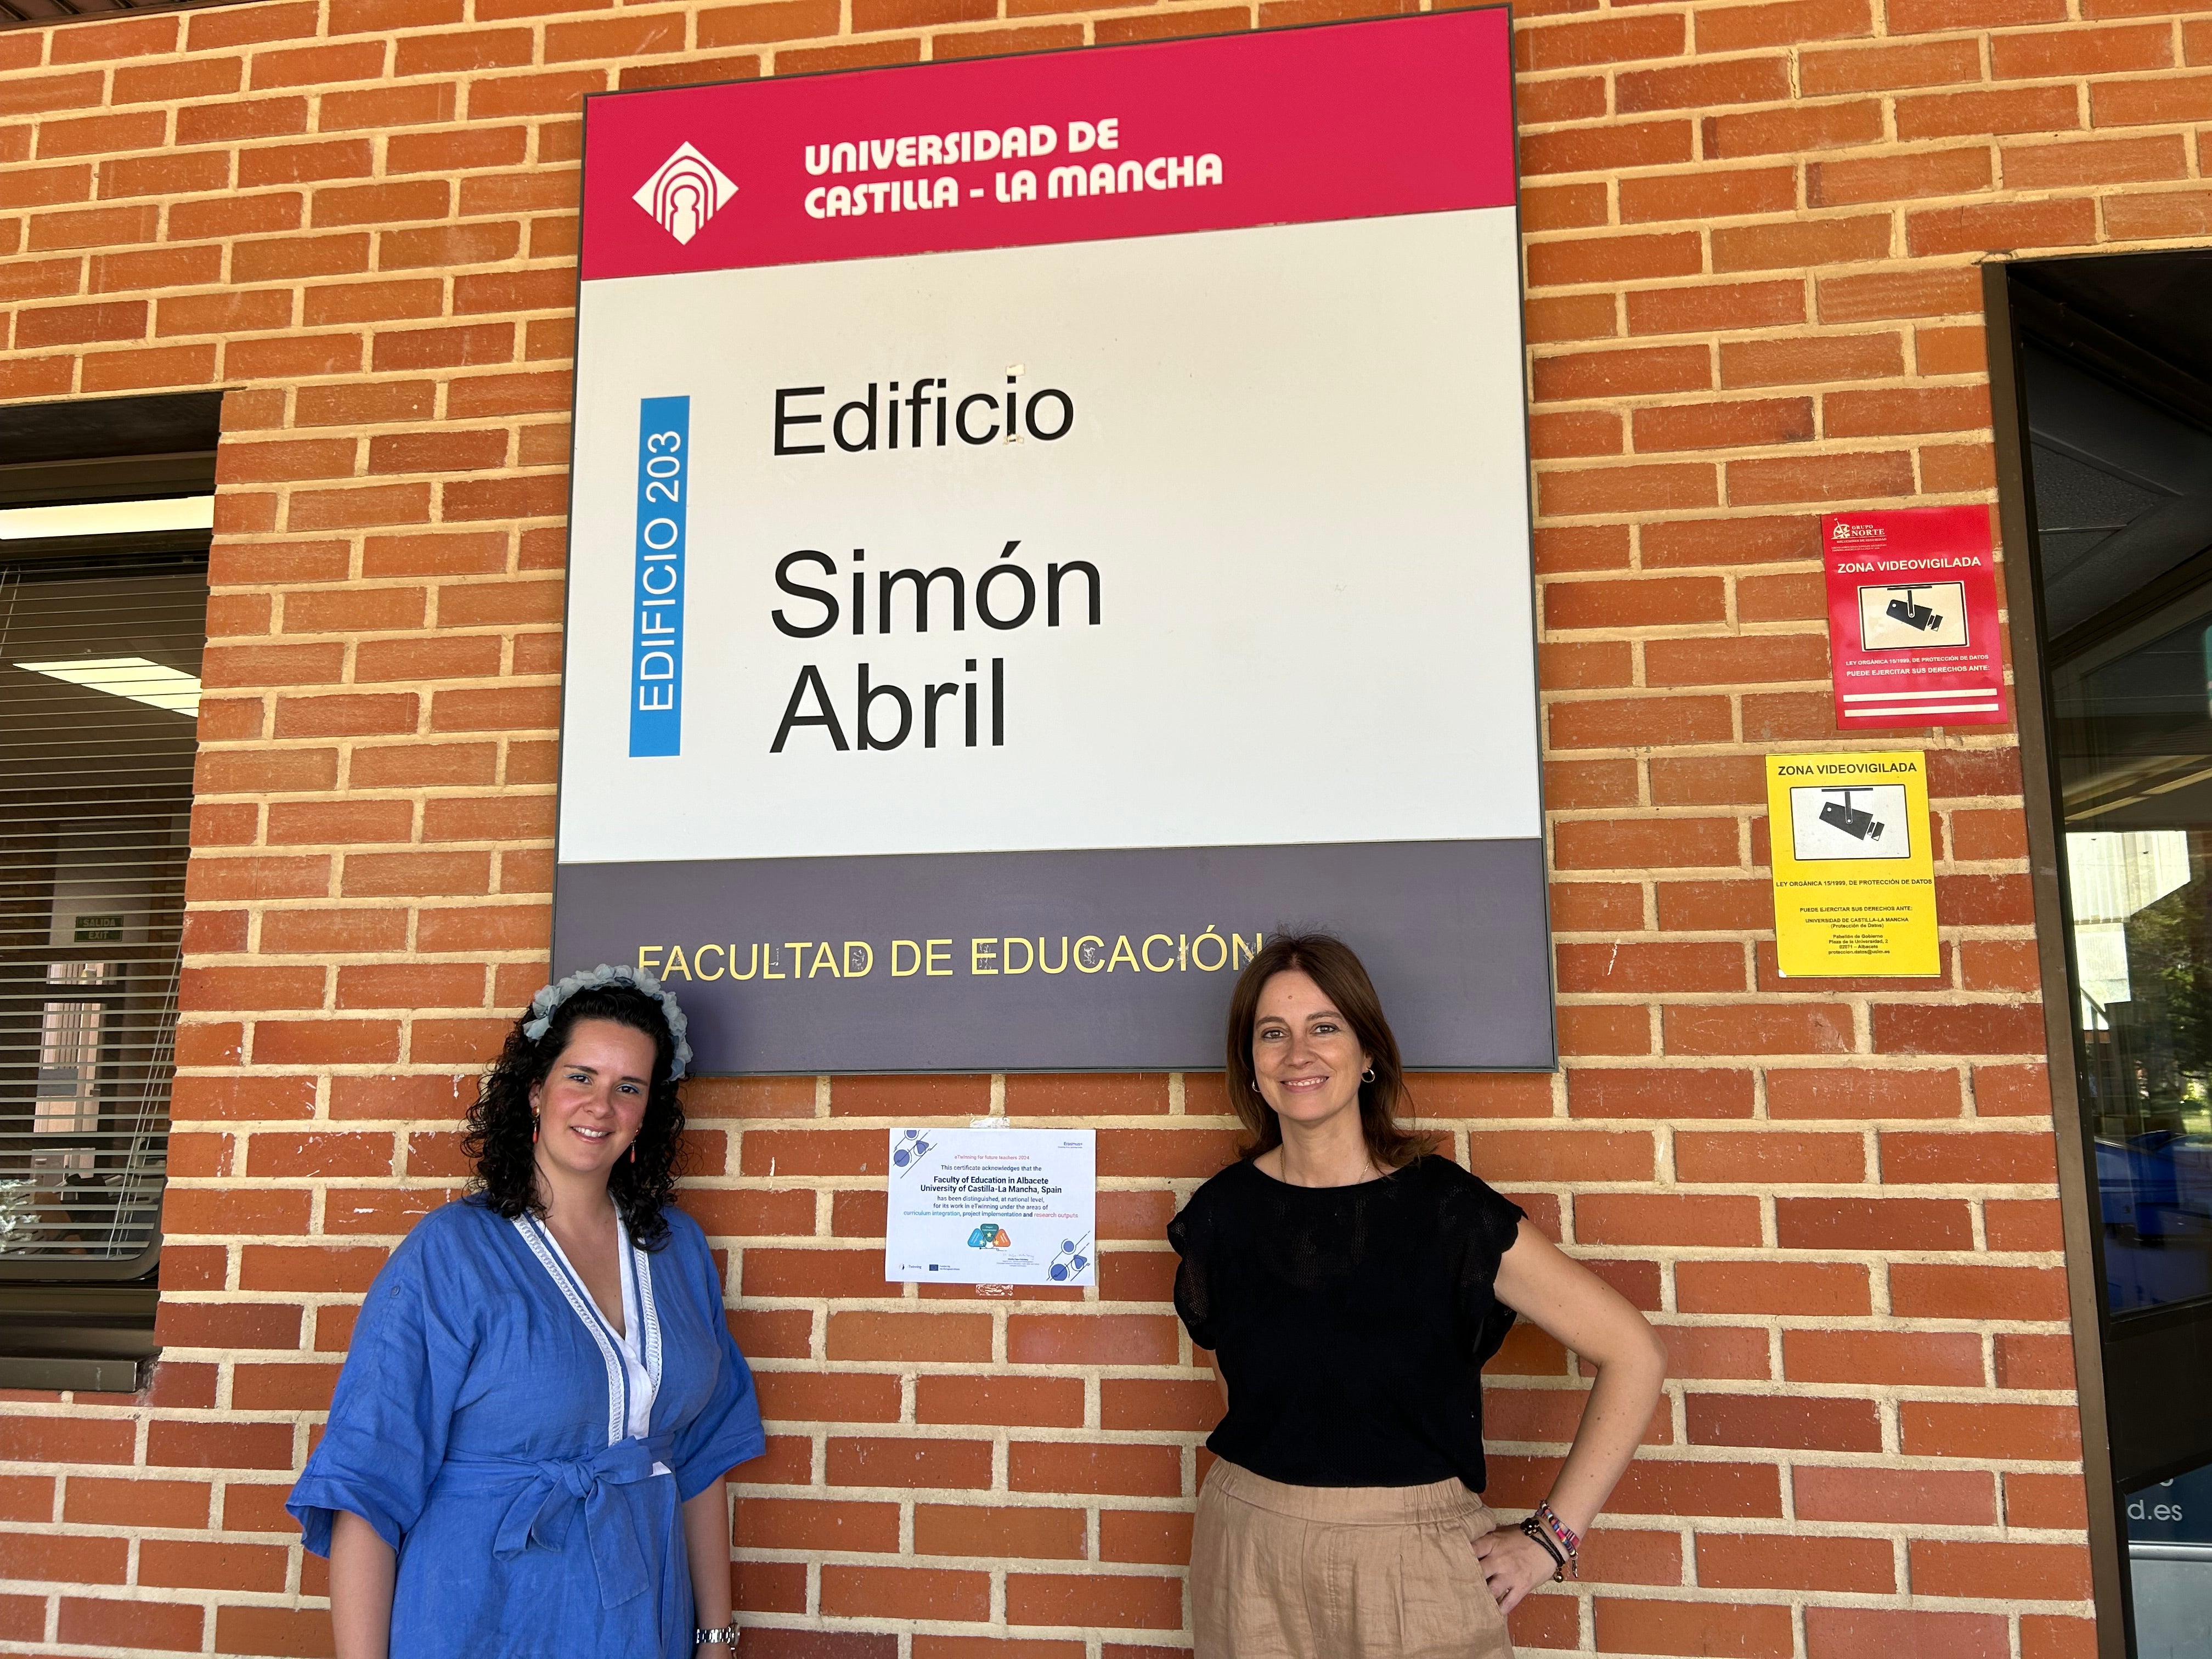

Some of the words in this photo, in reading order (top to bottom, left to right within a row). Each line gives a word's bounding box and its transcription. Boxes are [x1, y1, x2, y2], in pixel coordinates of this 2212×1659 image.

[805, 125, 1057, 176] UNIVERSIDAD
[1069, 117, 1119, 153] DE
[805, 176, 959, 218] CASTILLA
[969, 187, 984, 198] -
[995, 169, 1036, 203] LA
[1048, 153, 1223, 199] MANCHA
[774, 375, 1074, 455] Edificio
[645, 430, 681, 503] 203
[771, 540, 1101, 638] Simón
[1838, 562, 1875, 573] ZONA
[1877, 557, 1981, 572] VIDEOVIGILADA
[639, 517, 678, 710] EDIFICIO
[769, 657, 1004, 753] Abril
[1778, 765, 1814, 775] ZONA
[1816, 763, 1917, 775] VIDEOVIGILADA
[639, 941, 873, 981] FACULTAD
[891, 939, 953, 976] DE
[971, 924, 1262, 975] EDUCACIÓN
[921, 1184, 957, 1193] University
[1009, 1186, 1039, 1194] Mancha,
[1041, 1186, 1062, 1194] Spain
[934, 1176, 960, 1184] Faculty
